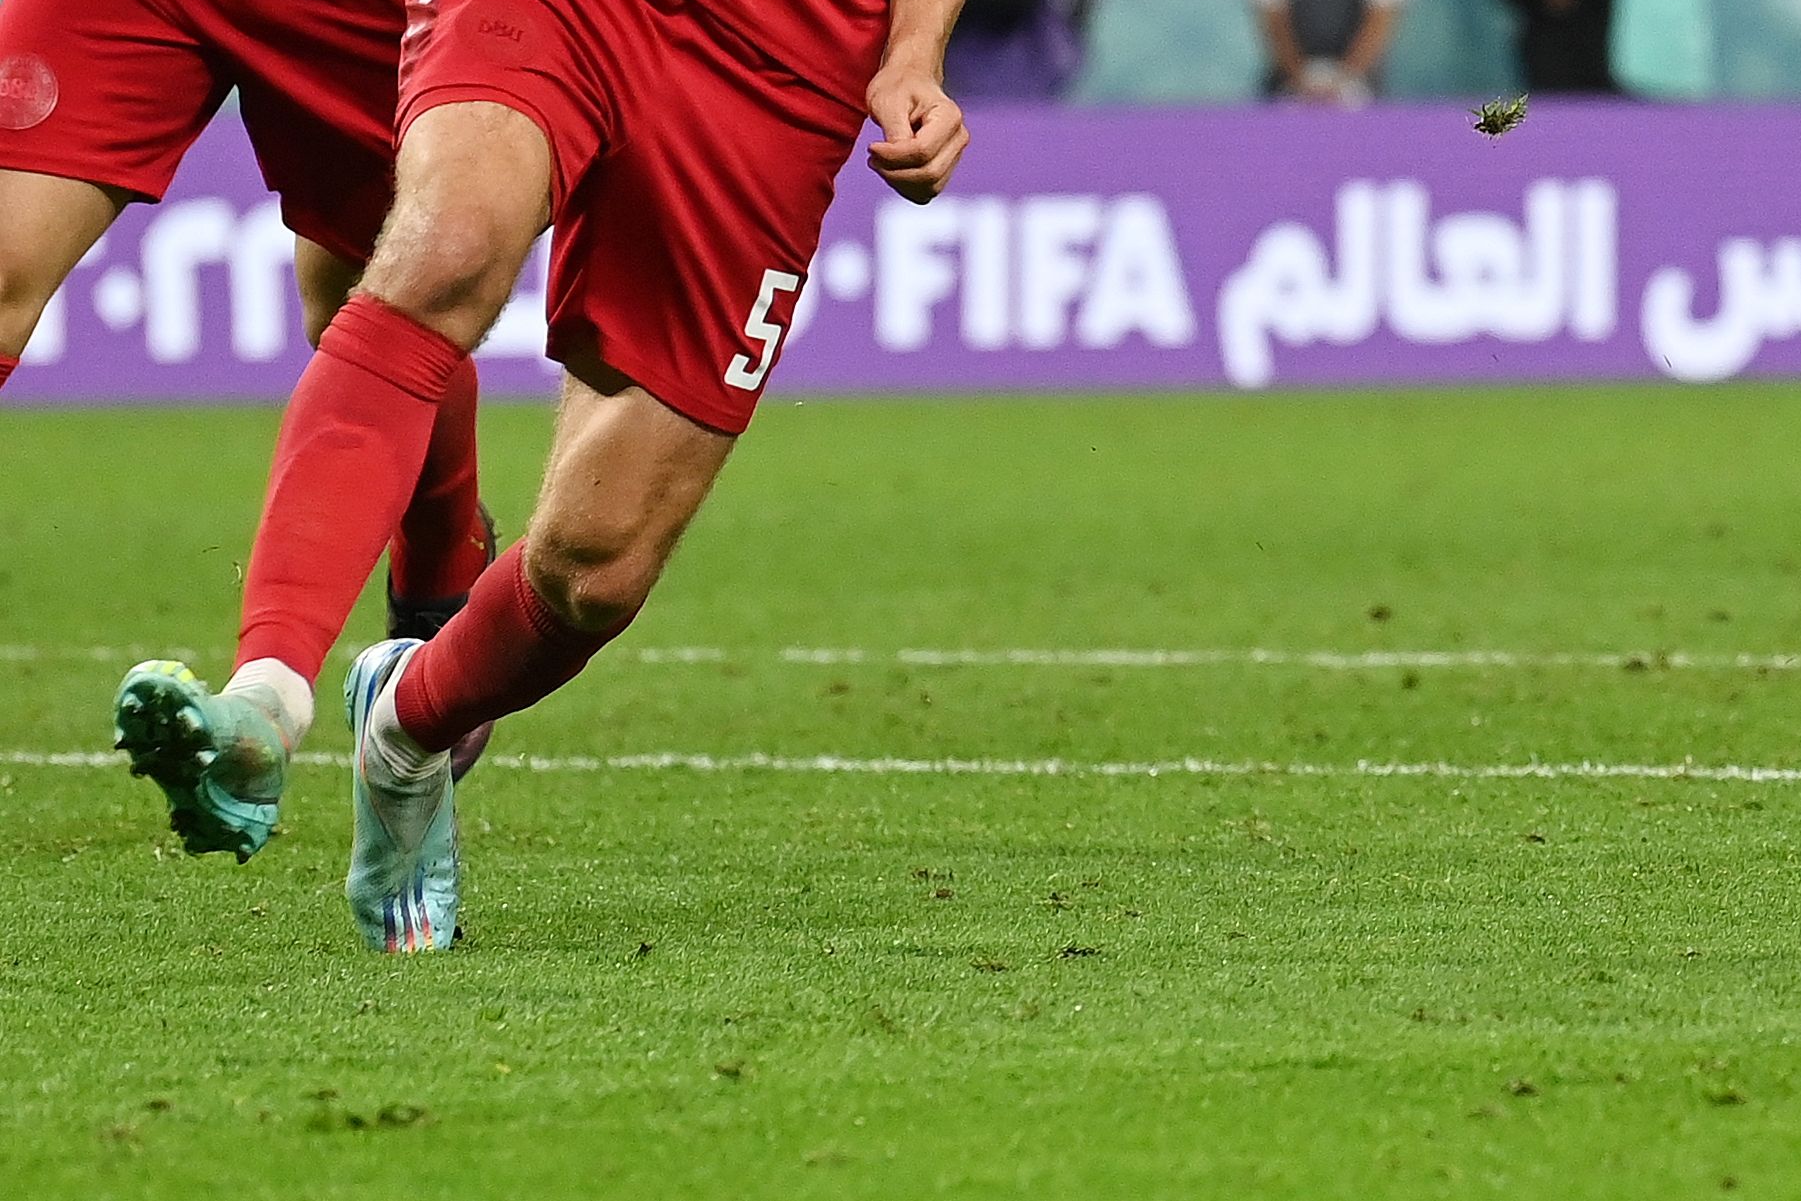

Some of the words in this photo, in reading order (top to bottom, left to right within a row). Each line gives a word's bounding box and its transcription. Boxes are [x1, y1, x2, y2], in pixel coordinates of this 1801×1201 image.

[724, 268, 800, 392] 5
[872, 193, 1197, 354] FIFA
[1216, 176, 1619, 390] العالم
